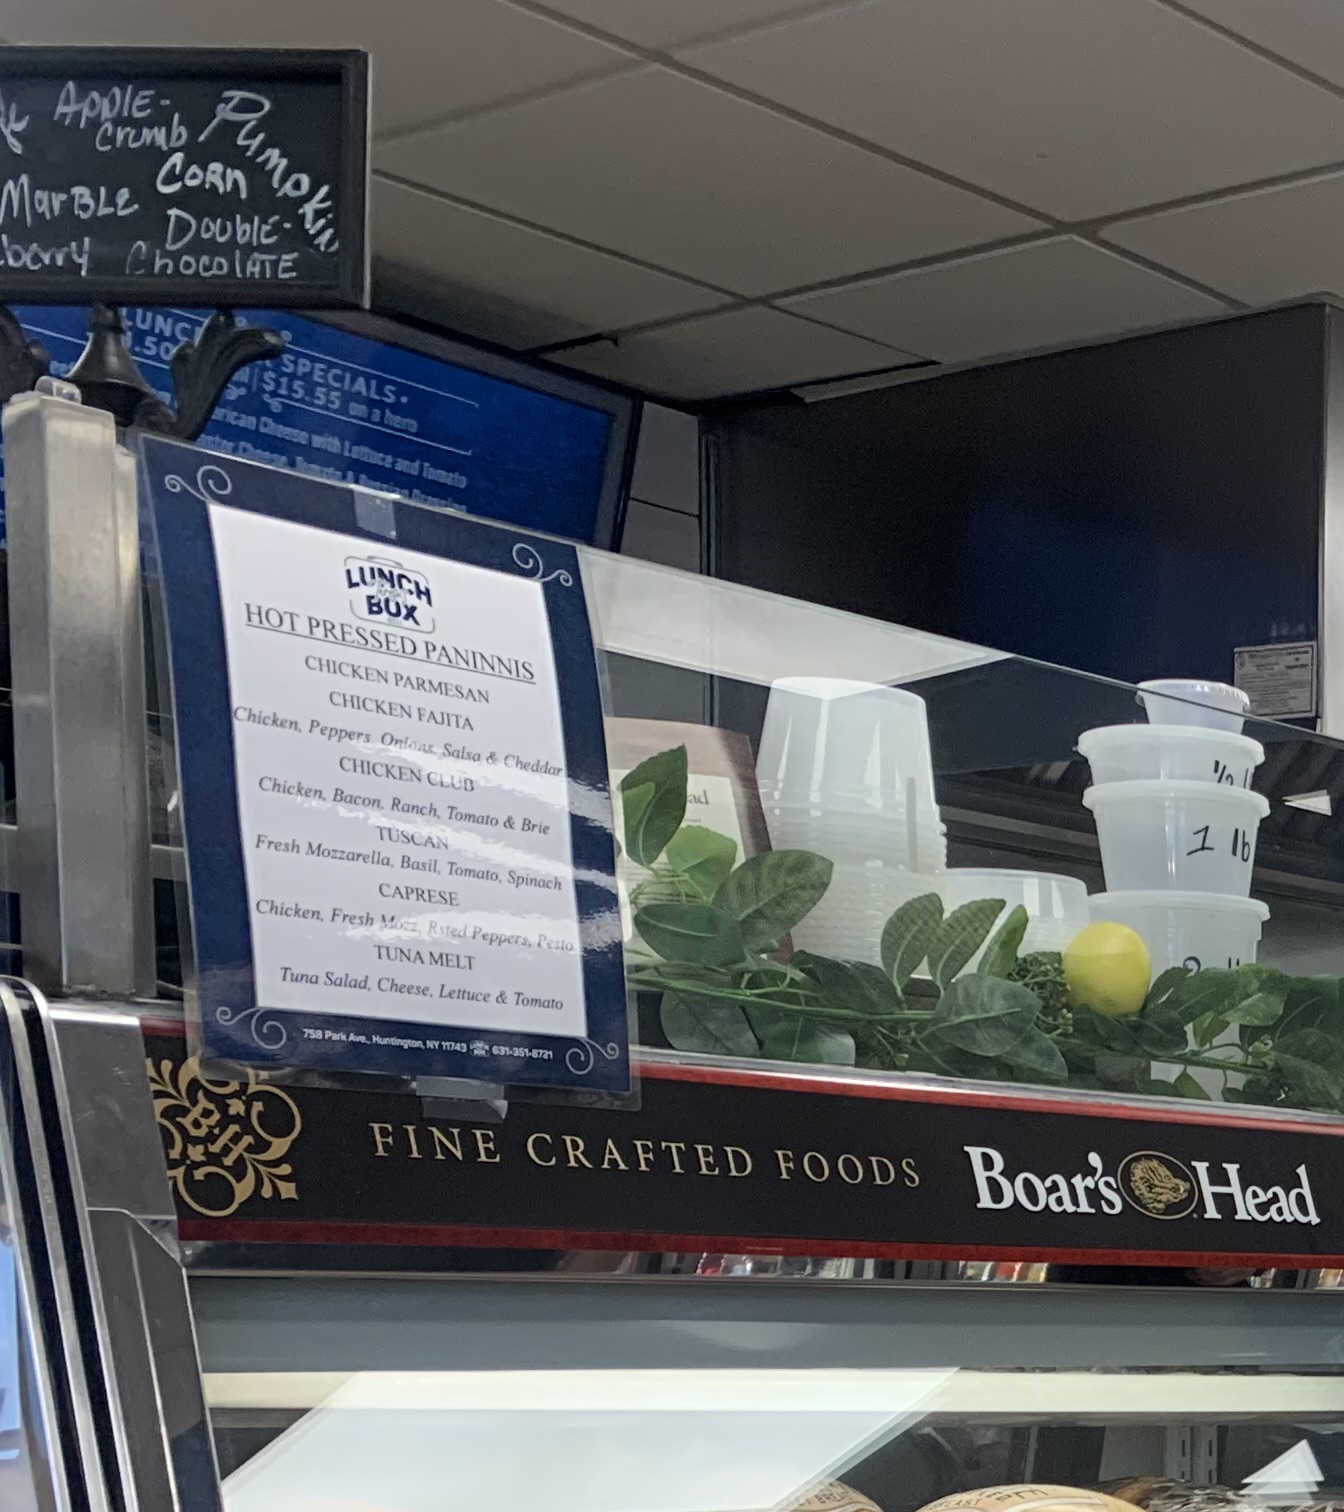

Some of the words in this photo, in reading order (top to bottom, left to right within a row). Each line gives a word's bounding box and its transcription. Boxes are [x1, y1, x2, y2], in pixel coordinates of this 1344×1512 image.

[262, 373, 341, 410] $15.55
[280, 354, 397, 404] SPECIALS
[345, 567, 433, 607] LUNCH
[366, 595, 420, 626] BOX
[245, 603, 299, 632] HOT
[307, 615, 417, 656] PRESSED
[425, 640, 536, 680] PANINNIS
[305, 655, 389, 685] CHICKEN
[393, 672, 489, 703] PARMESAN
[339, 756, 422, 784] CHICKEN
[427, 770, 475, 792] CLUB
[259, 776, 325, 802] Chicken,
[333, 787, 385, 810] Bacon,
[391, 797, 441, 819] Ranch,
[447, 806, 499, 828] Tomato
[503, 816, 514, 830] &
[521, 817, 550, 835] Brie
[375, 826, 449, 851] TUSCAN
[378, 883, 460, 907] CAPRESE
[373, 944, 425, 965] TUNA
[429, 950, 475, 971] MELT
[280, 967, 319, 986] Tuna
[324, 972, 372, 992] Salad,
[377, 977, 433, 998] Cheese,
[439, 984, 491, 1004] Lettuce
[496, 991, 507, 1004] &
[514, 992, 564, 1011] Tomato
[368, 1122, 501, 1164] FINE
[526, 1132, 753, 1179] CRAFTED
[775, 1149, 920, 1188] FOODS
[964, 1145, 1122, 1216] Boar's
[1199, 1161, 1321, 1226] Head
